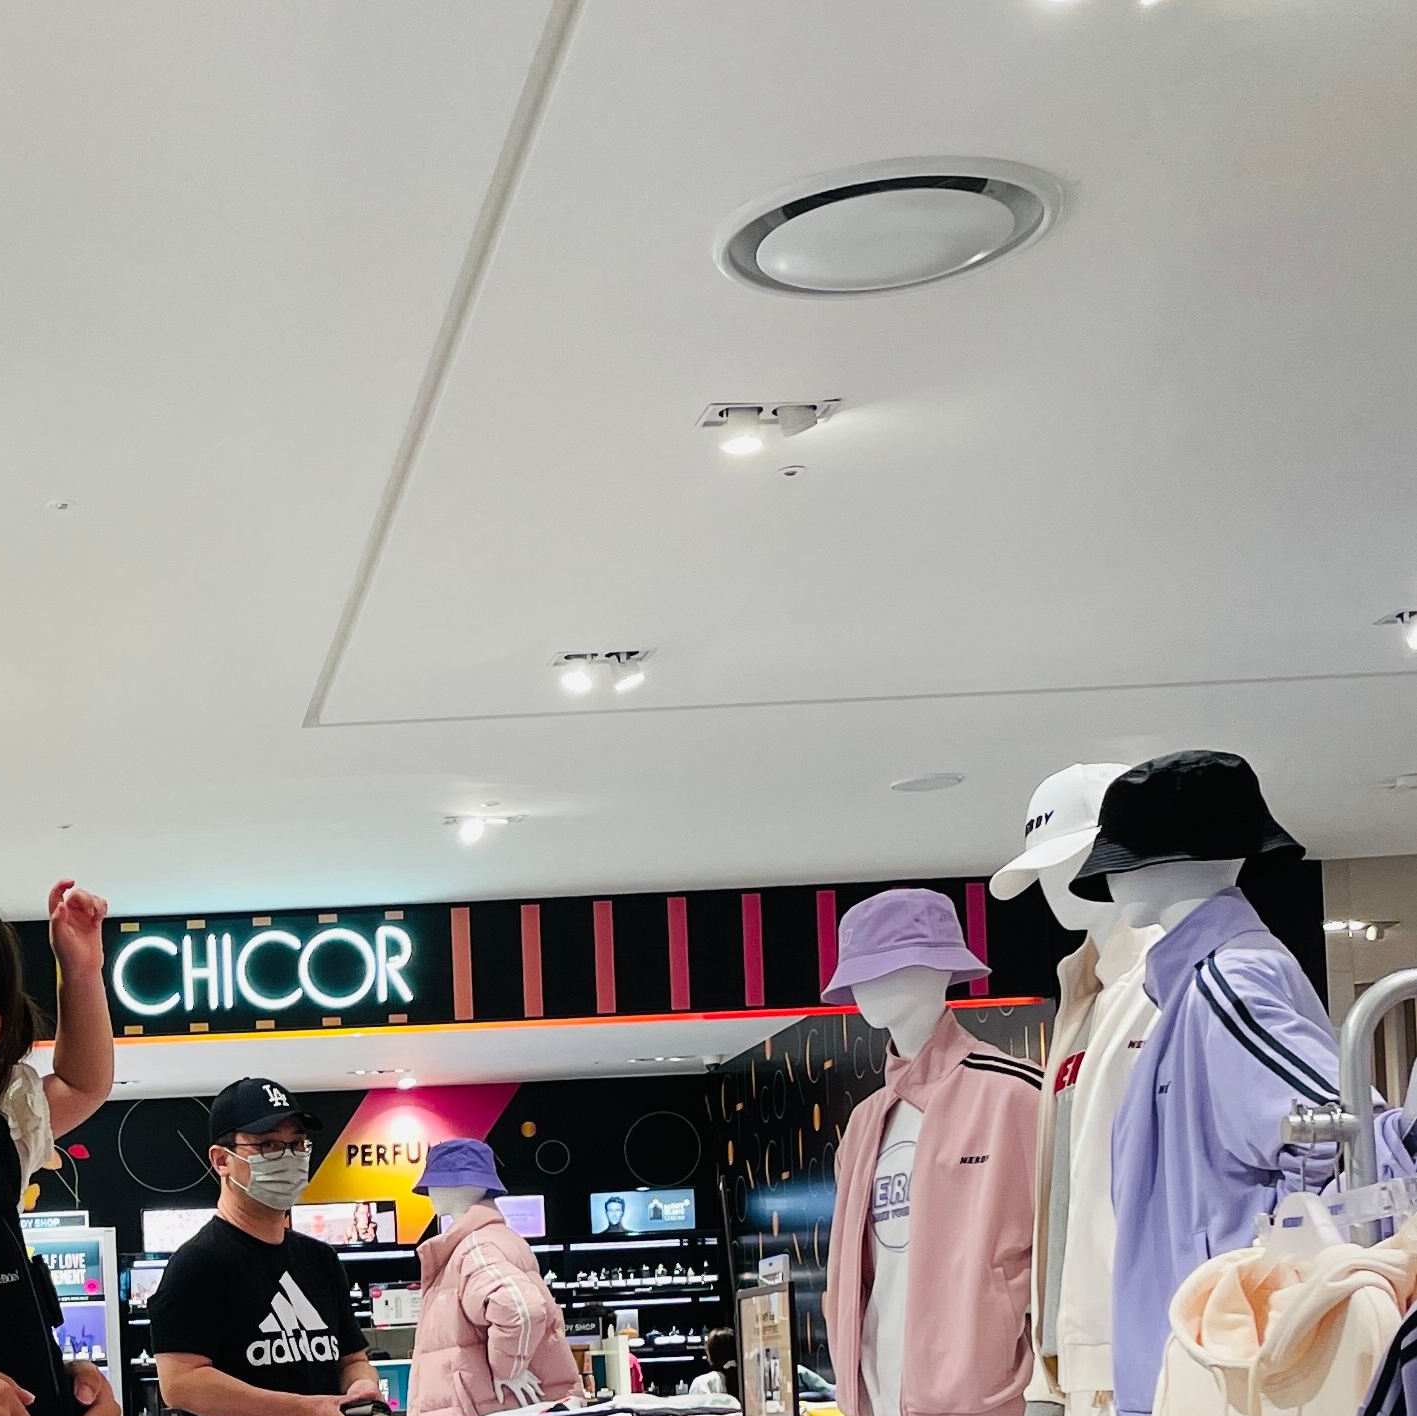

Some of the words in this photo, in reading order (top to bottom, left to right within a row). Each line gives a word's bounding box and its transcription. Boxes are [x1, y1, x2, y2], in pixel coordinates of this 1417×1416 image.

[112, 925, 415, 1016] CHICOR
[262, 1084, 290, 1107] LA
[347, 1140, 442, 1168] PERFU
[34, 1218, 61, 1228] SHOP
[59, 1253, 86, 1269] LOVE
[246, 1329, 339, 1366] adidas
